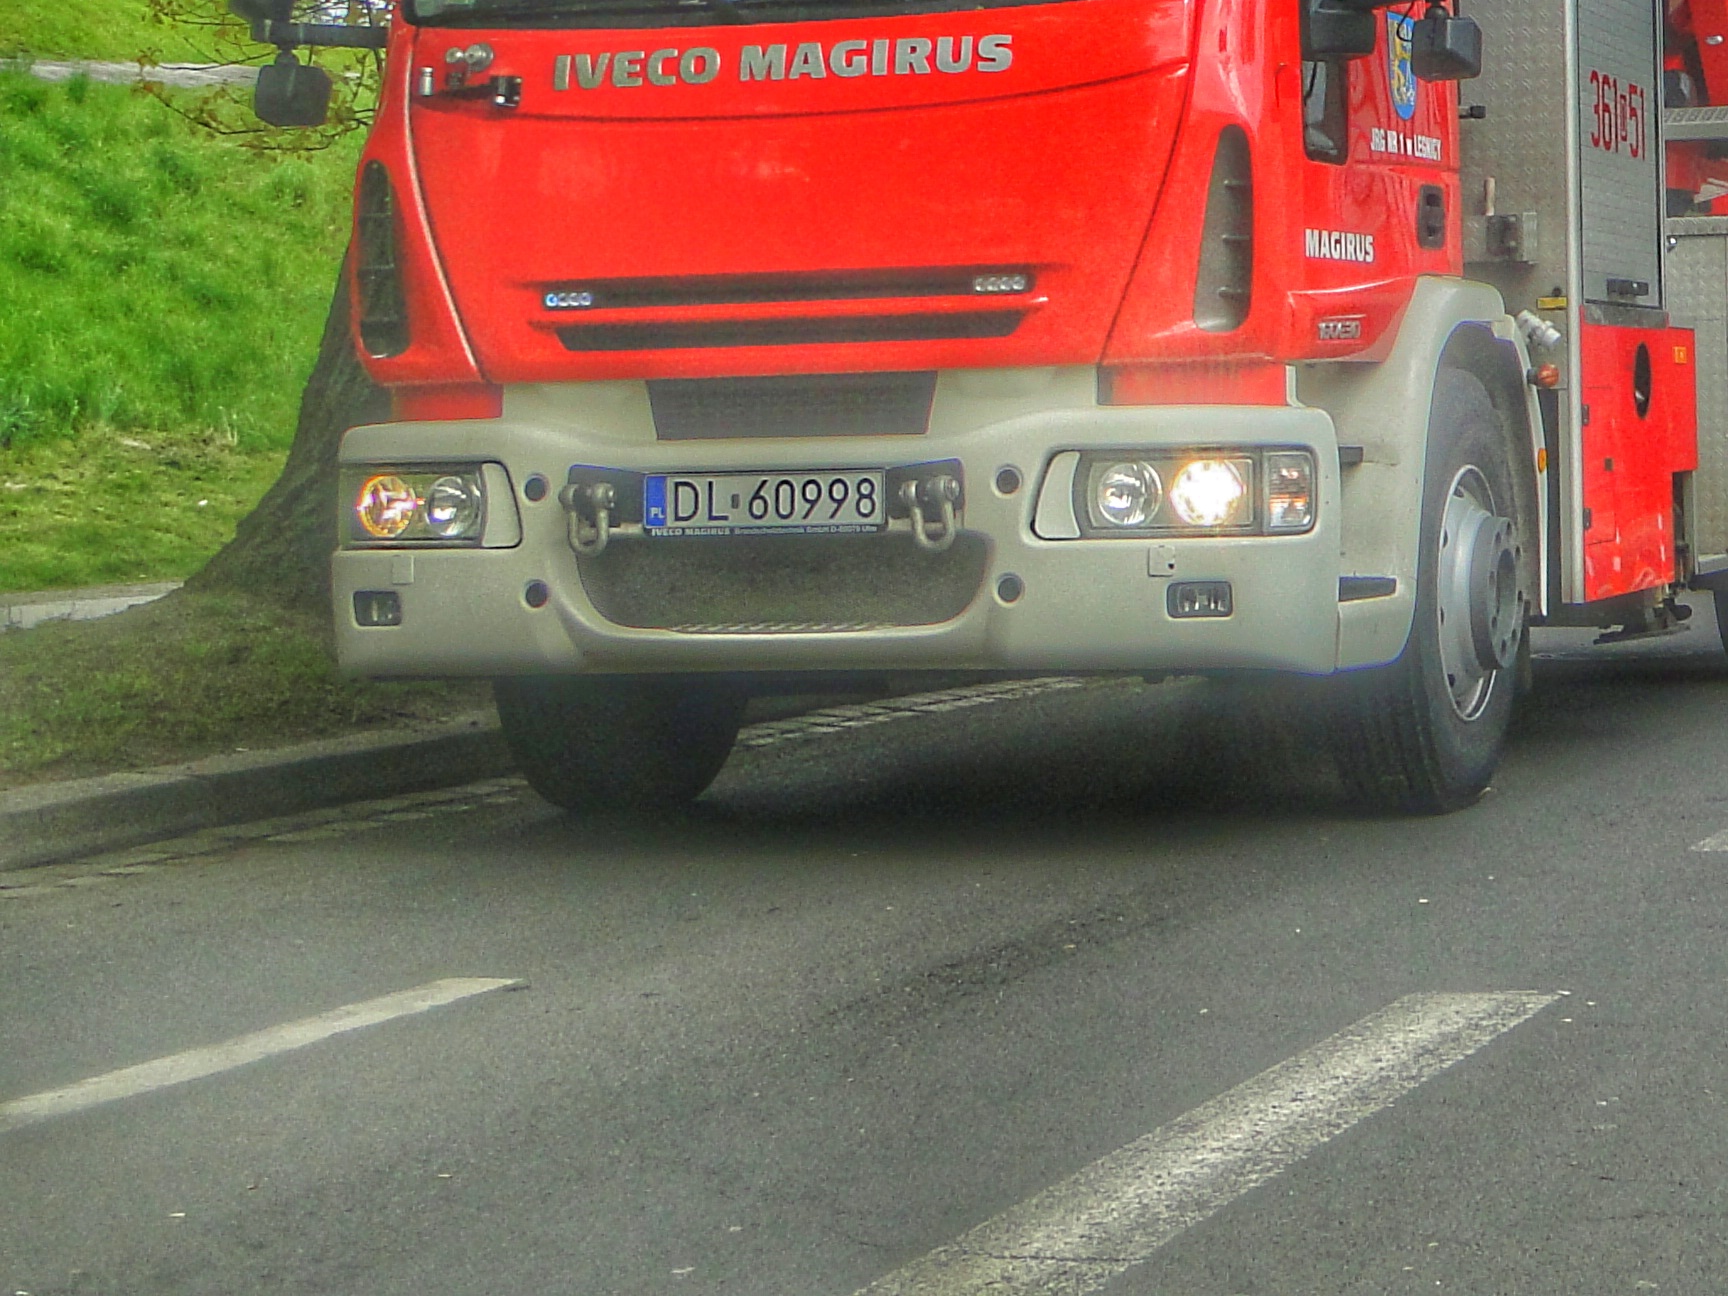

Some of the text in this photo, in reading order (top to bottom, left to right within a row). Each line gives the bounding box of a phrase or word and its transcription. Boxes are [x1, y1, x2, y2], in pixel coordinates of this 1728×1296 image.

[553, 34, 1013, 91] IVECO MAGIRUS
[1305, 228, 1374, 263] MAGIRUS
[650, 507, 665, 518] PL
[674, 477, 877, 522] DL 60998
[651, 528, 682, 537] IVECO
[684, 527, 731, 536] MAGIRUS
